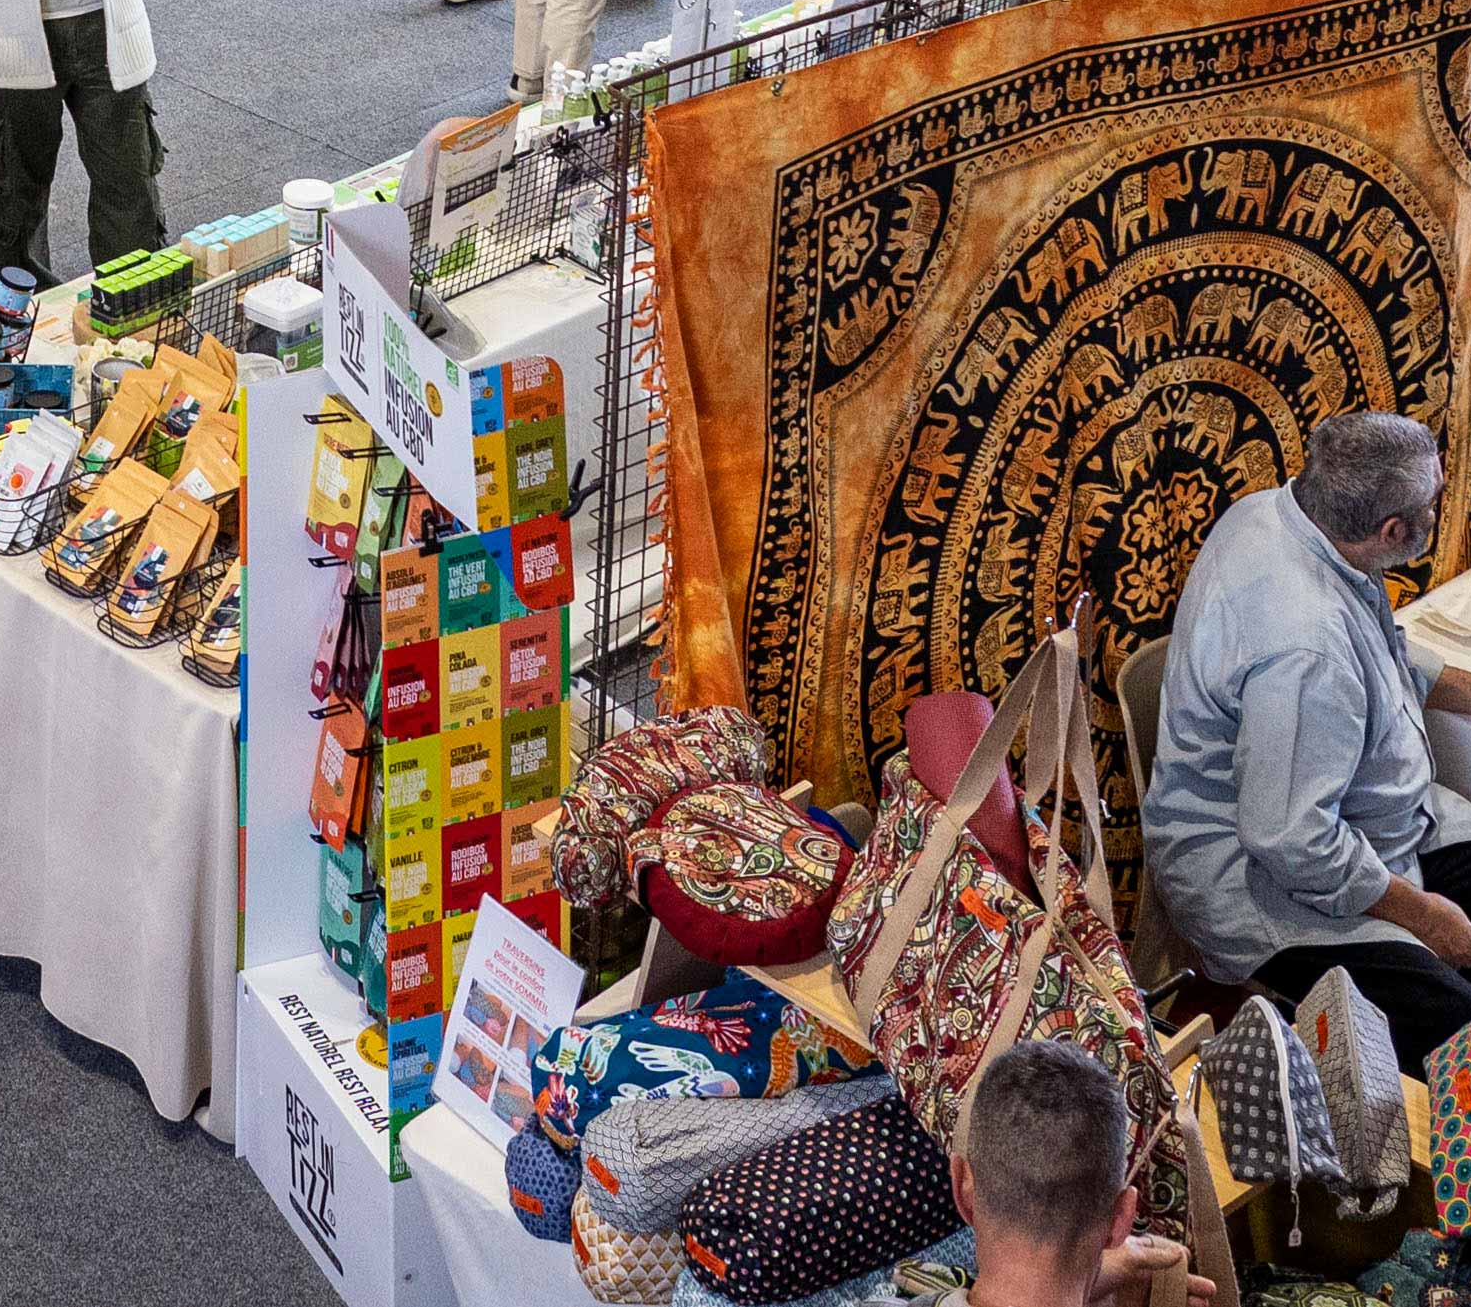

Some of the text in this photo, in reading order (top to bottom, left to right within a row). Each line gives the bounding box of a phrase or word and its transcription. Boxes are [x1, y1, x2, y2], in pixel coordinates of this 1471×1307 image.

[383, 310, 410, 359] 100%
[383, 336, 426, 406] NATUREL
[512, 364, 550, 382] INFUSION
[513, 377, 543, 392] AU CBD
[384, 365, 434, 447] INFUSION
[386, 404, 425, 467] AU CBD
[521, 543, 556, 564] ROOIBOS
[522, 553, 559, 573] INFUSION
[386, 565, 414, 582] ABSOLU
[463, 559, 486, 576] VERT
[448, 570, 485, 590] INFUSION
[449, 657, 477, 672] COLADA
[389, 759, 418, 775] CITRON
[390, 850, 424, 868] VANILLE
[451, 842, 486, 861] ROOIBOS
[391, 954, 426, 972] ROOIBOS
[500, 937, 546, 978] TRAVERSINS
[513, 981, 549, 1016] SOMMEIL
[279, 994, 390, 1134] REST NATUREL REST RELAX
[286, 1083, 336, 1195] REST IN
